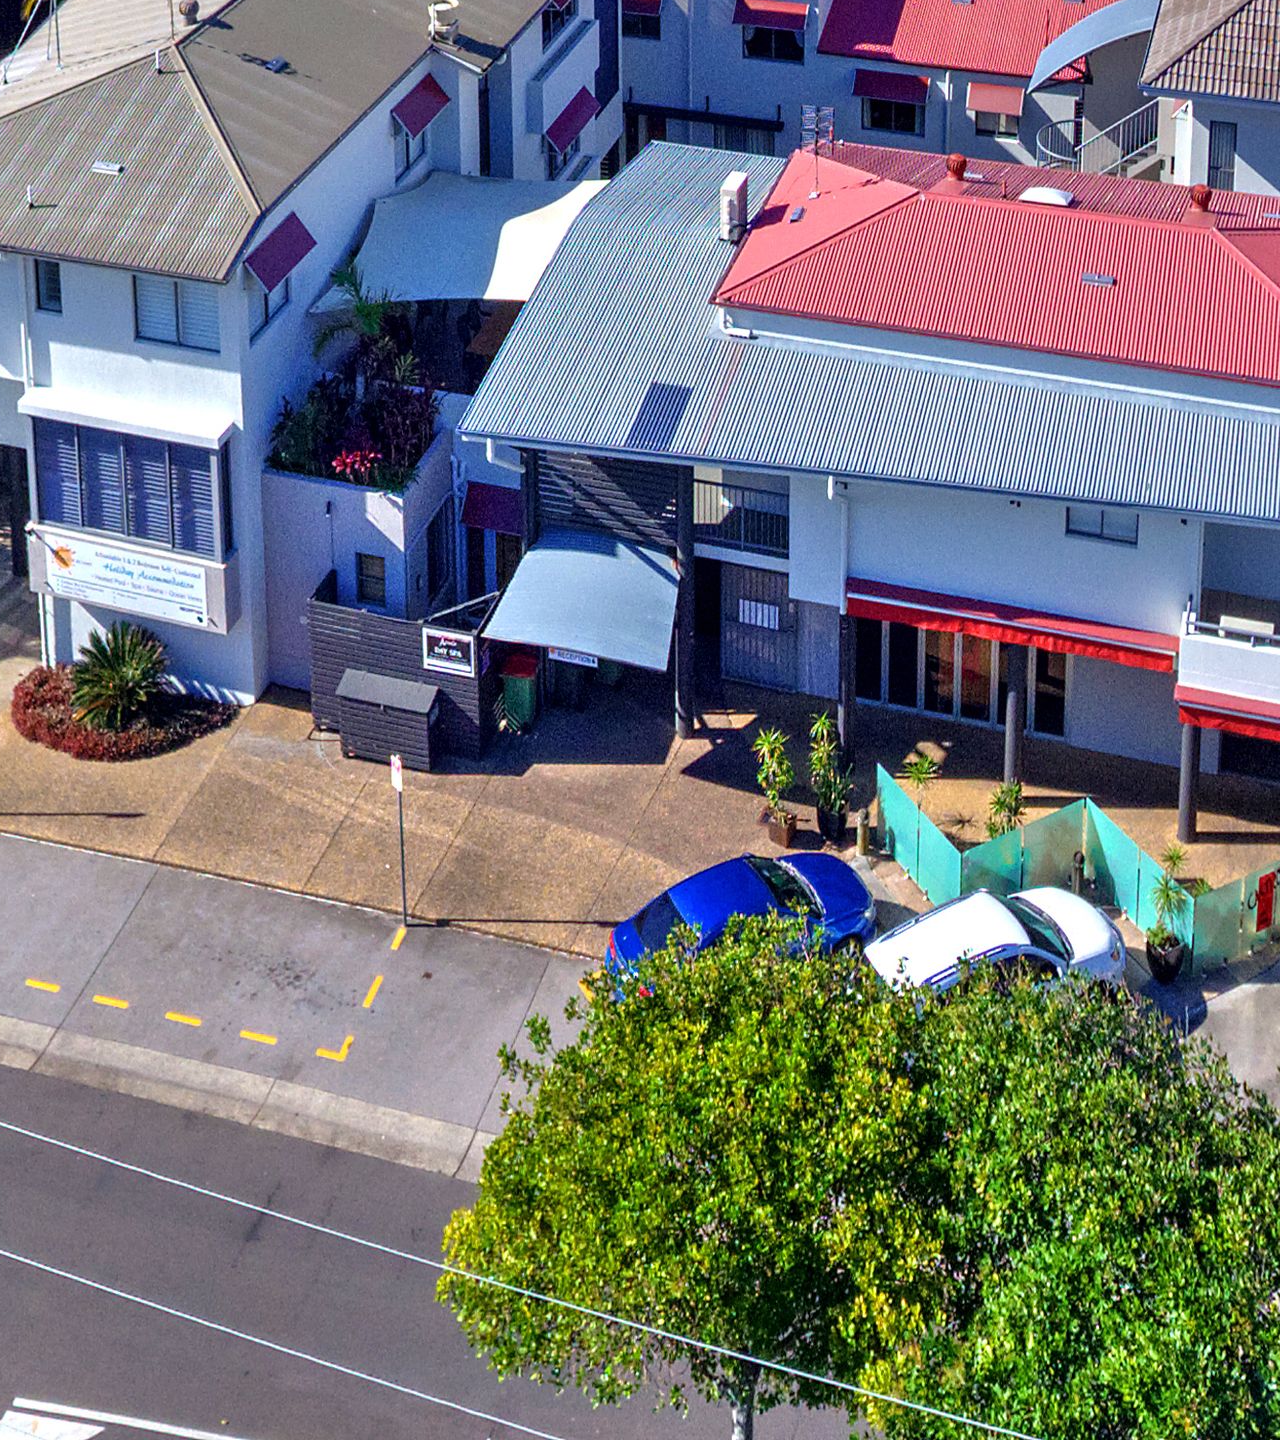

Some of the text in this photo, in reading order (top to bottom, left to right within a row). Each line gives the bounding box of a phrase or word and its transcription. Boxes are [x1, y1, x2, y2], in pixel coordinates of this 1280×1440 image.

[102, 563, 194, 588] Holiday Accommodation
[558, 649, 591, 664] RECEPTION
